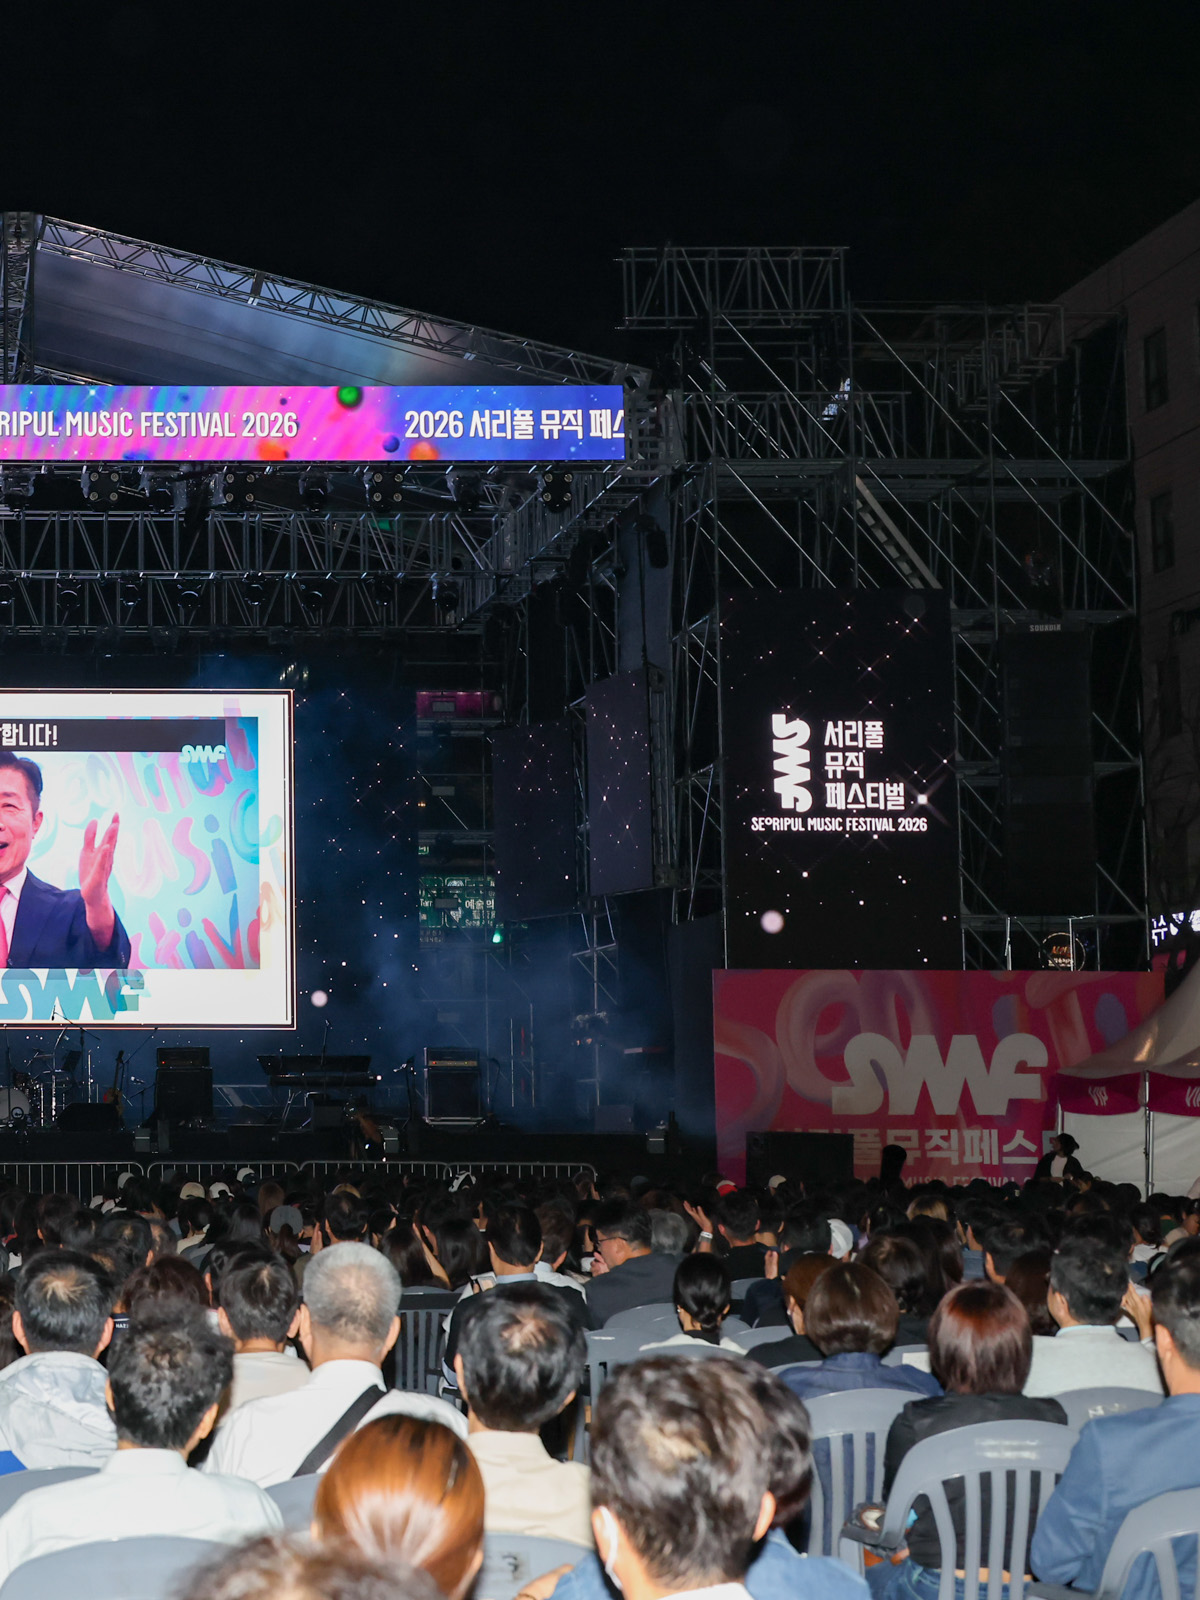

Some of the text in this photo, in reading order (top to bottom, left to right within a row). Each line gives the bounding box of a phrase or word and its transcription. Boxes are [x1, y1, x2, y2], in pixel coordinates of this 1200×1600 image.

[65, 410, 133, 437] MUSIC
[140, 410, 236, 437] FESTIVAL
[241, 411, 298, 437] 2026
[404, 411, 464, 438] 2026
[469, 409, 535, 440] 서리풀
[540, 409, 583, 439] 뮤직
[823, 720, 885, 749] 서리풀
[824, 751, 864, 779] 뮤직
[824, 782, 905, 811] 페스티벌
[807, 817, 843, 832] MUSIC
[845, 817, 896, 832] FESTIVAL
[898, 817, 928, 832] 2026
